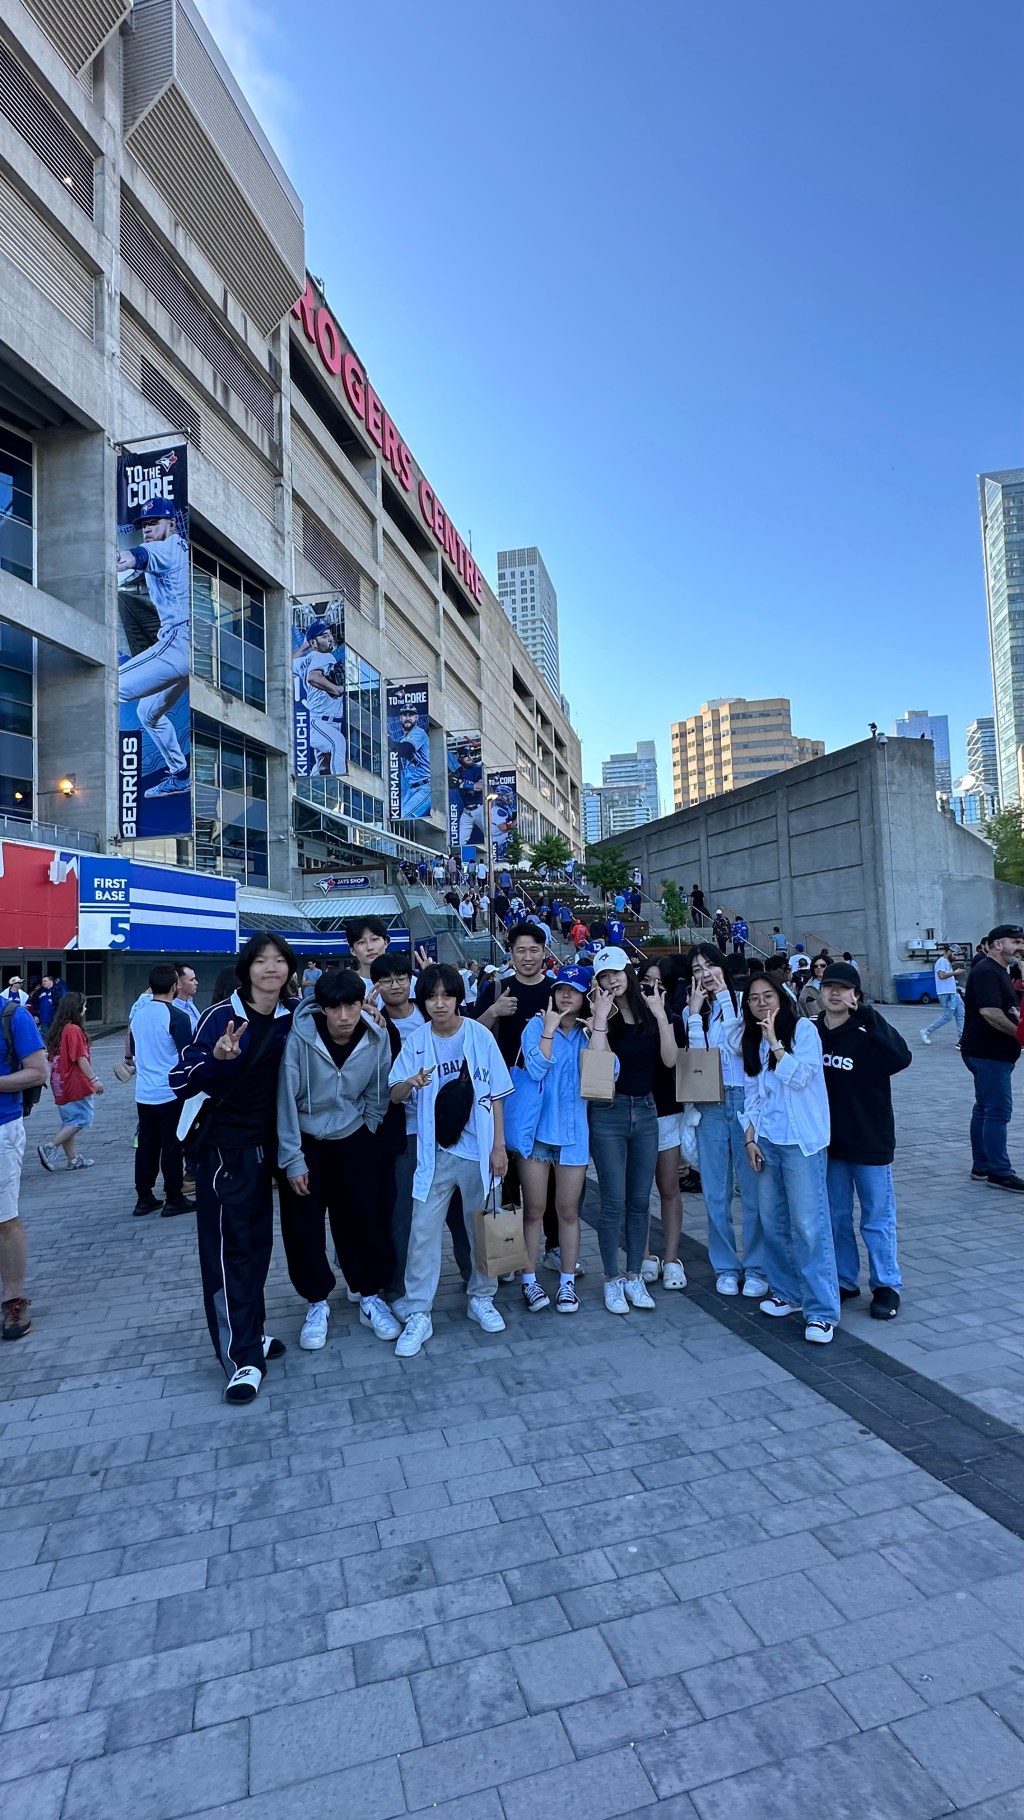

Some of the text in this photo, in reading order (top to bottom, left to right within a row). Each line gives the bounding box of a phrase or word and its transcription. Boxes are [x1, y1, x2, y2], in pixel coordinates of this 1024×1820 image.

[290, 277, 483, 606] ROGERS CENTRE
[126, 465, 161, 484] TO THE
[127, 475, 174, 508] CORE
[388, 696, 398, 706] TO
[405, 692, 427, 704] CORE
[296, 711, 308, 777] KIKUCHI
[119, 737, 138, 838] BERRÍOS
[390, 751, 399, 819] KIERMAIER
[499, 776, 516, 785] CORE
[450, 803, 458, 846] TURNER
[93, 877, 128, 889] FIRST
[95, 889, 126, 901] BASE
[108, 916, 130, 949] 5
[612, 924, 619, 933] 4
